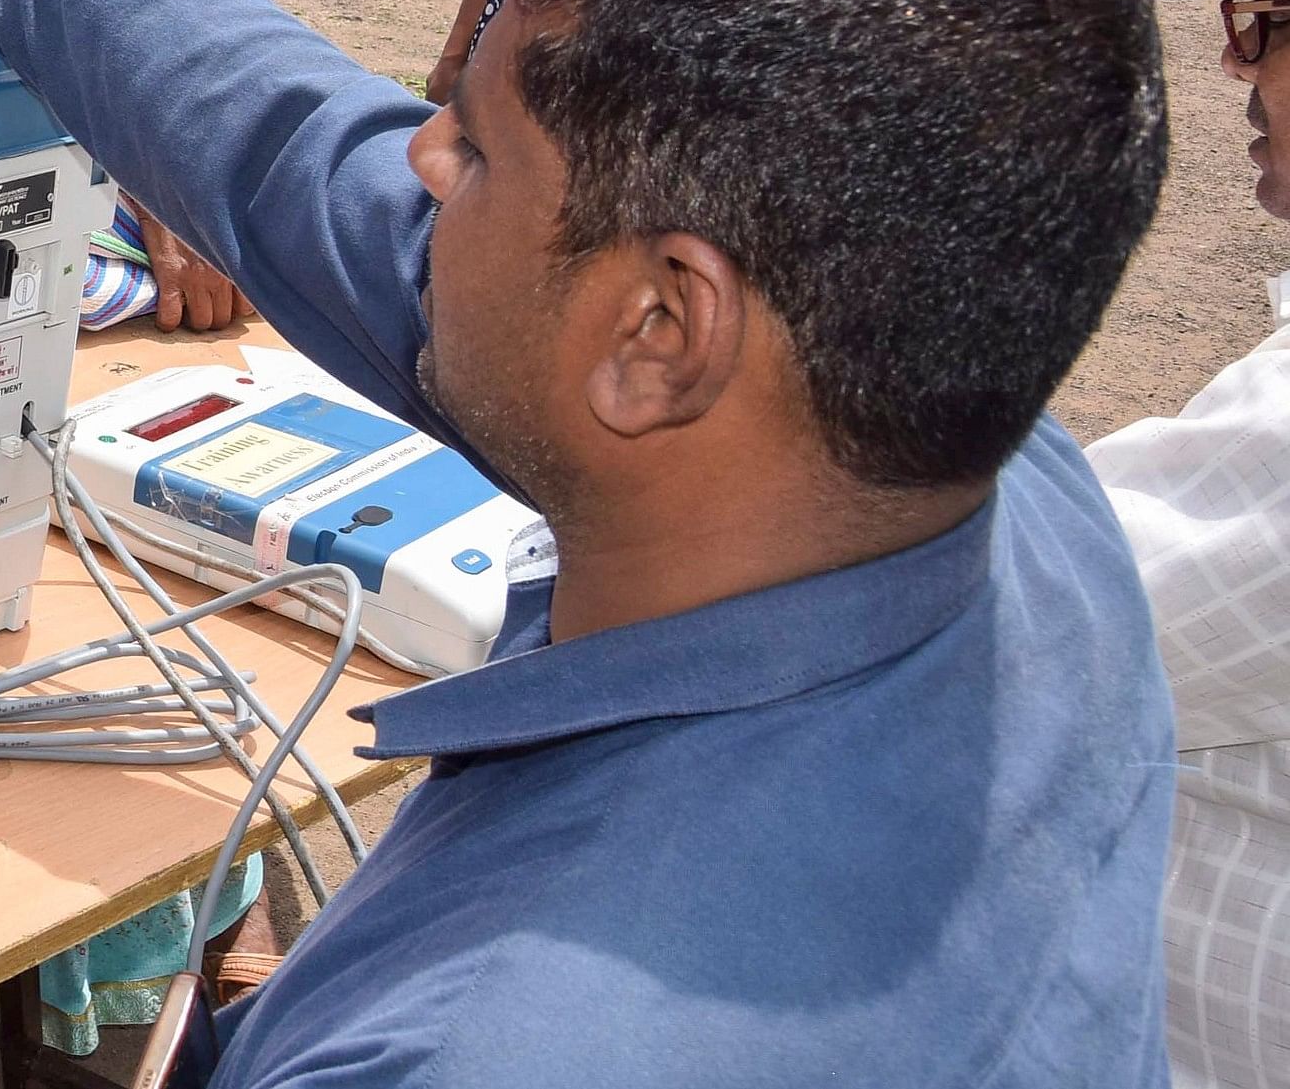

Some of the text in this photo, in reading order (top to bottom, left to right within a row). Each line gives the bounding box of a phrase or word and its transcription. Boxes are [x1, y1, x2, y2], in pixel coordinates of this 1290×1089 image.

[176, 434, 270, 472] Training
[225, 444, 314, 486] Awarness
[307, 445, 419, 502] Election Commission of India
